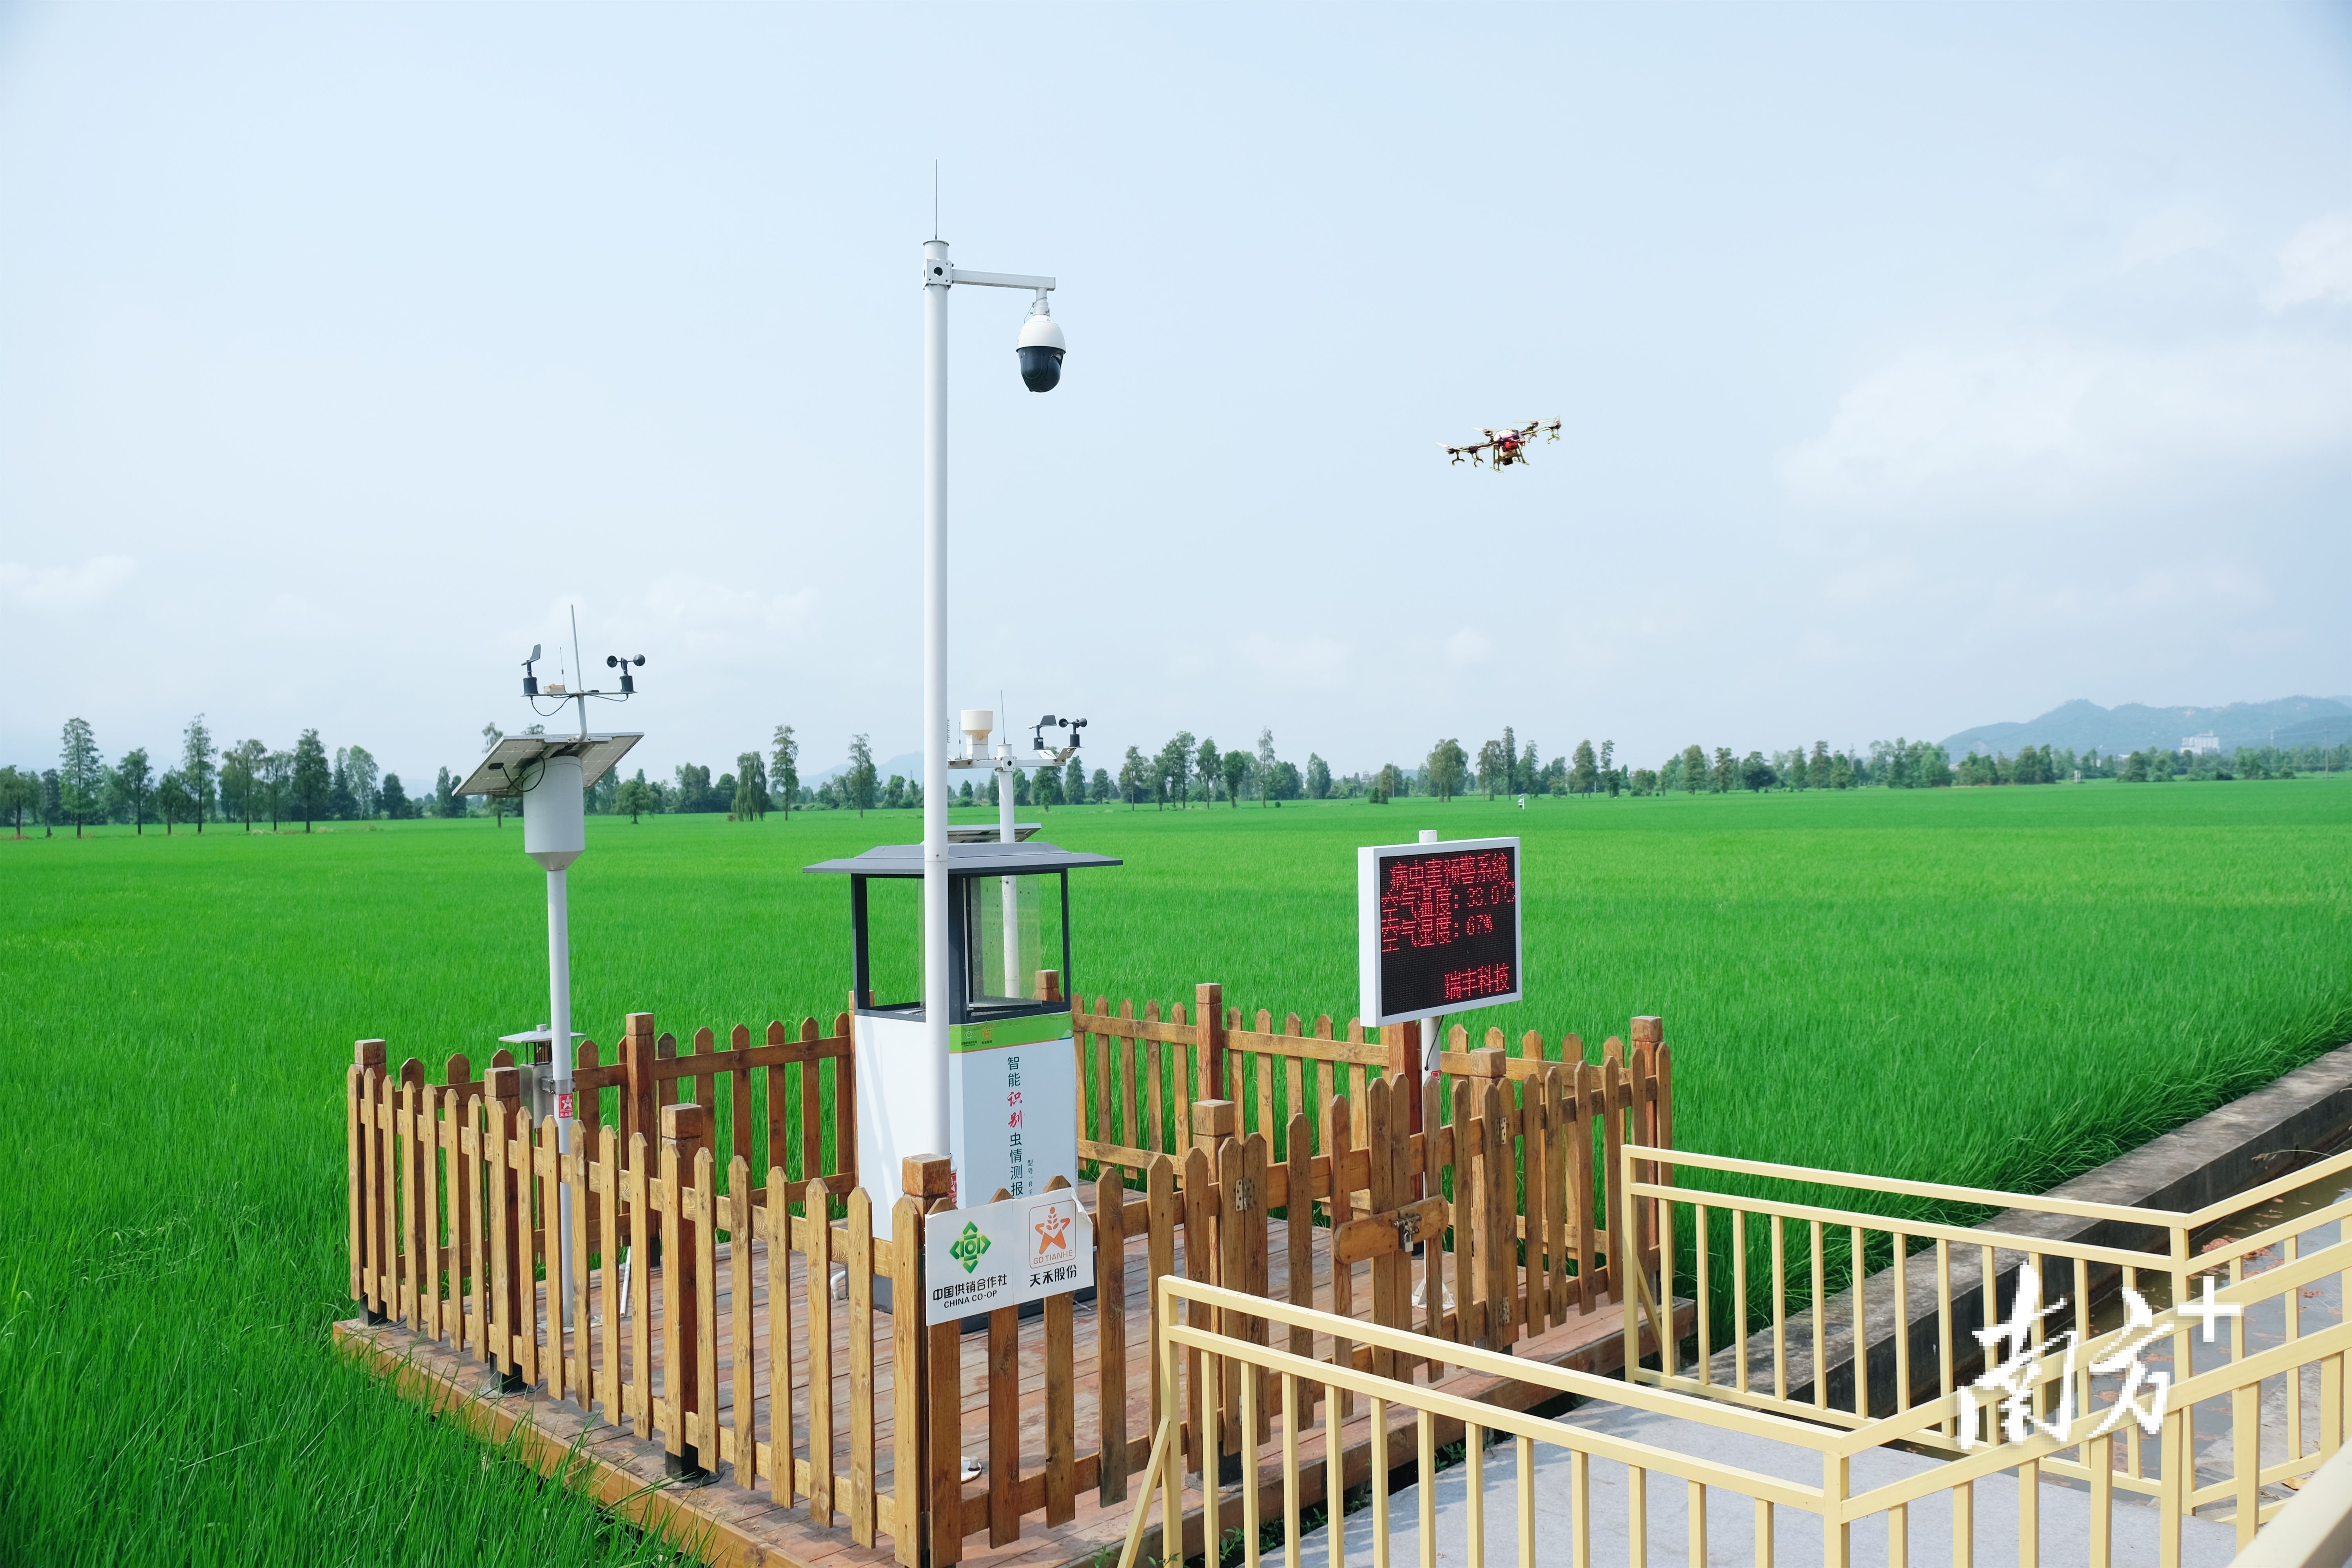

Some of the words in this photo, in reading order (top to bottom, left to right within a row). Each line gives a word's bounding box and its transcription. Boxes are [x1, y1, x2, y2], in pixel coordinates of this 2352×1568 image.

[1390, 853, 1508, 891] 病虫害预警系统
[1444, 962, 1510, 1000] 瑞丰科技
[1007, 1056, 1024, 1198] 智能识别虫情测报
[1033, 1256, 1044, 1265] GD
[1045, 1249, 1073, 1261] TIANHE
[933, 1274, 1007, 1301] 中国供销合作社
[1029, 1264, 1077, 1288] 天禾股份
[944, 1296, 970, 1308] CHINA
[972, 1290, 997, 1301] CO-OP
